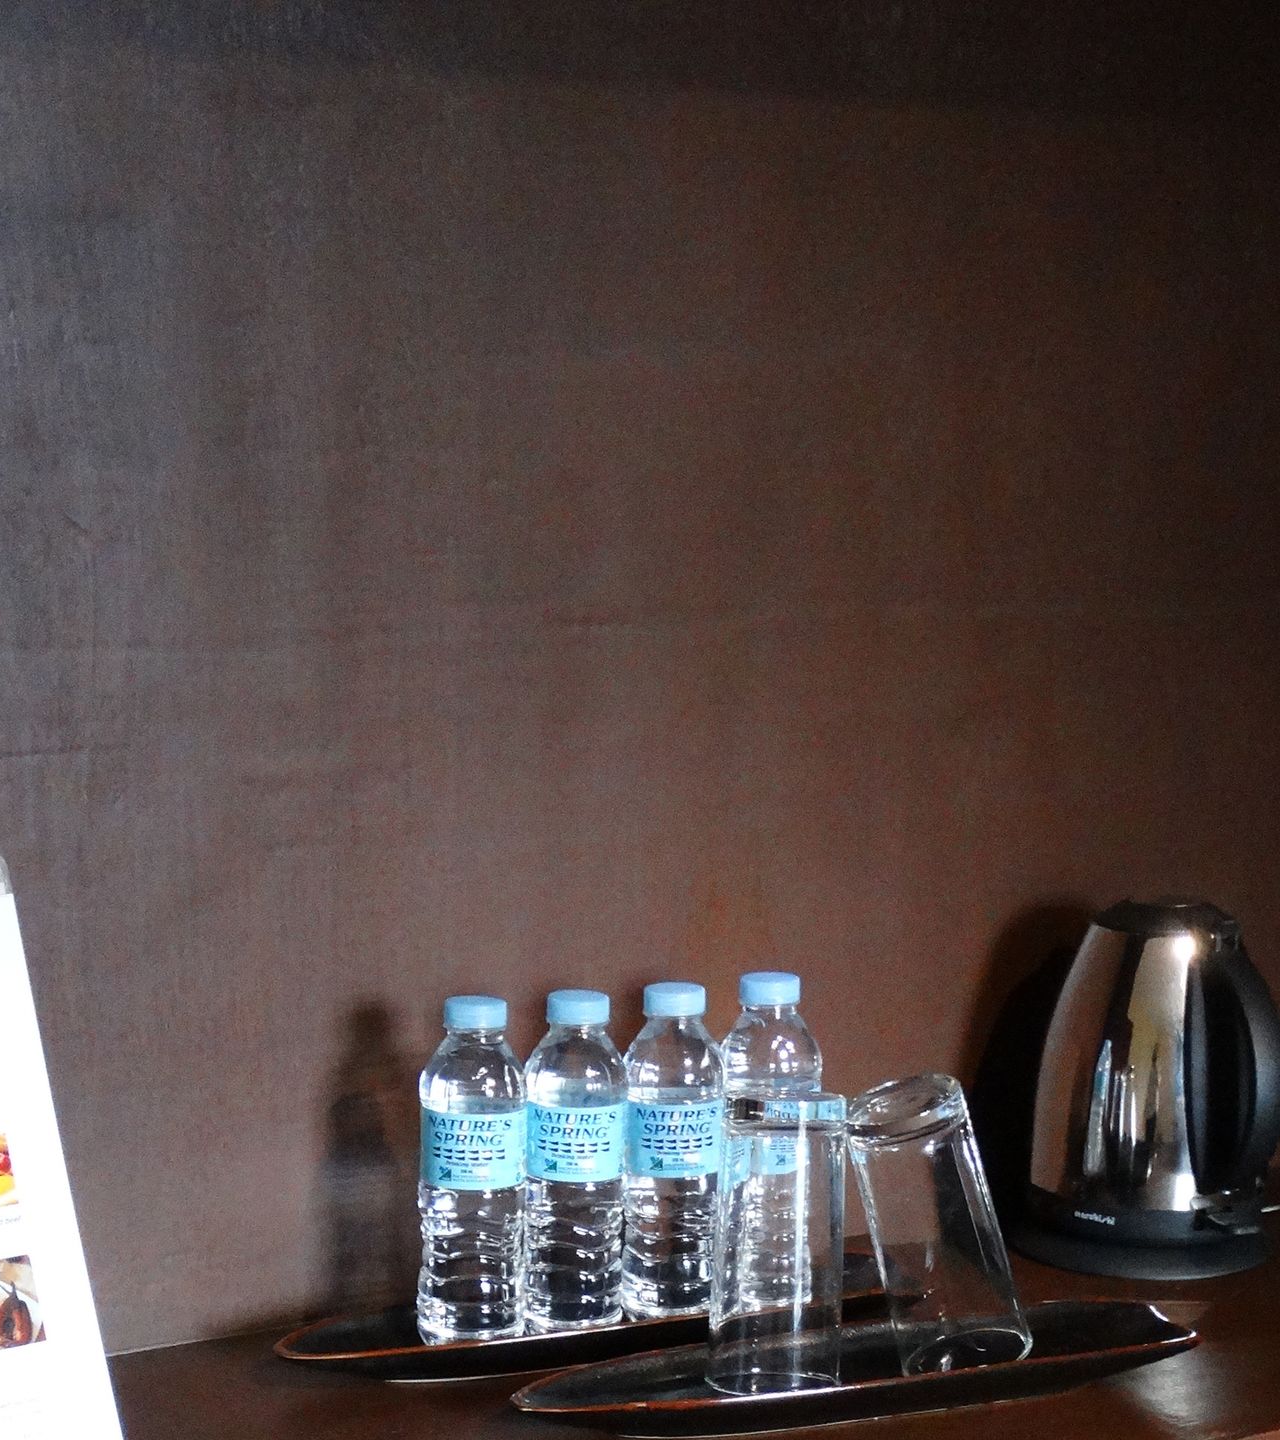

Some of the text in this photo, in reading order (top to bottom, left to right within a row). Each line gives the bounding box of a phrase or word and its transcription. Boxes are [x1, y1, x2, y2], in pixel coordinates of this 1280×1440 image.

[534, 1109, 617, 1126] NATURE'S
[636, 1106, 718, 1123] NATURE'S
[428, 1115, 512, 1132] NATURE'S
[643, 1121, 713, 1136] SPRING
[433, 1131, 504, 1147] SPRING
[539, 1124, 608, 1140] SPRING
